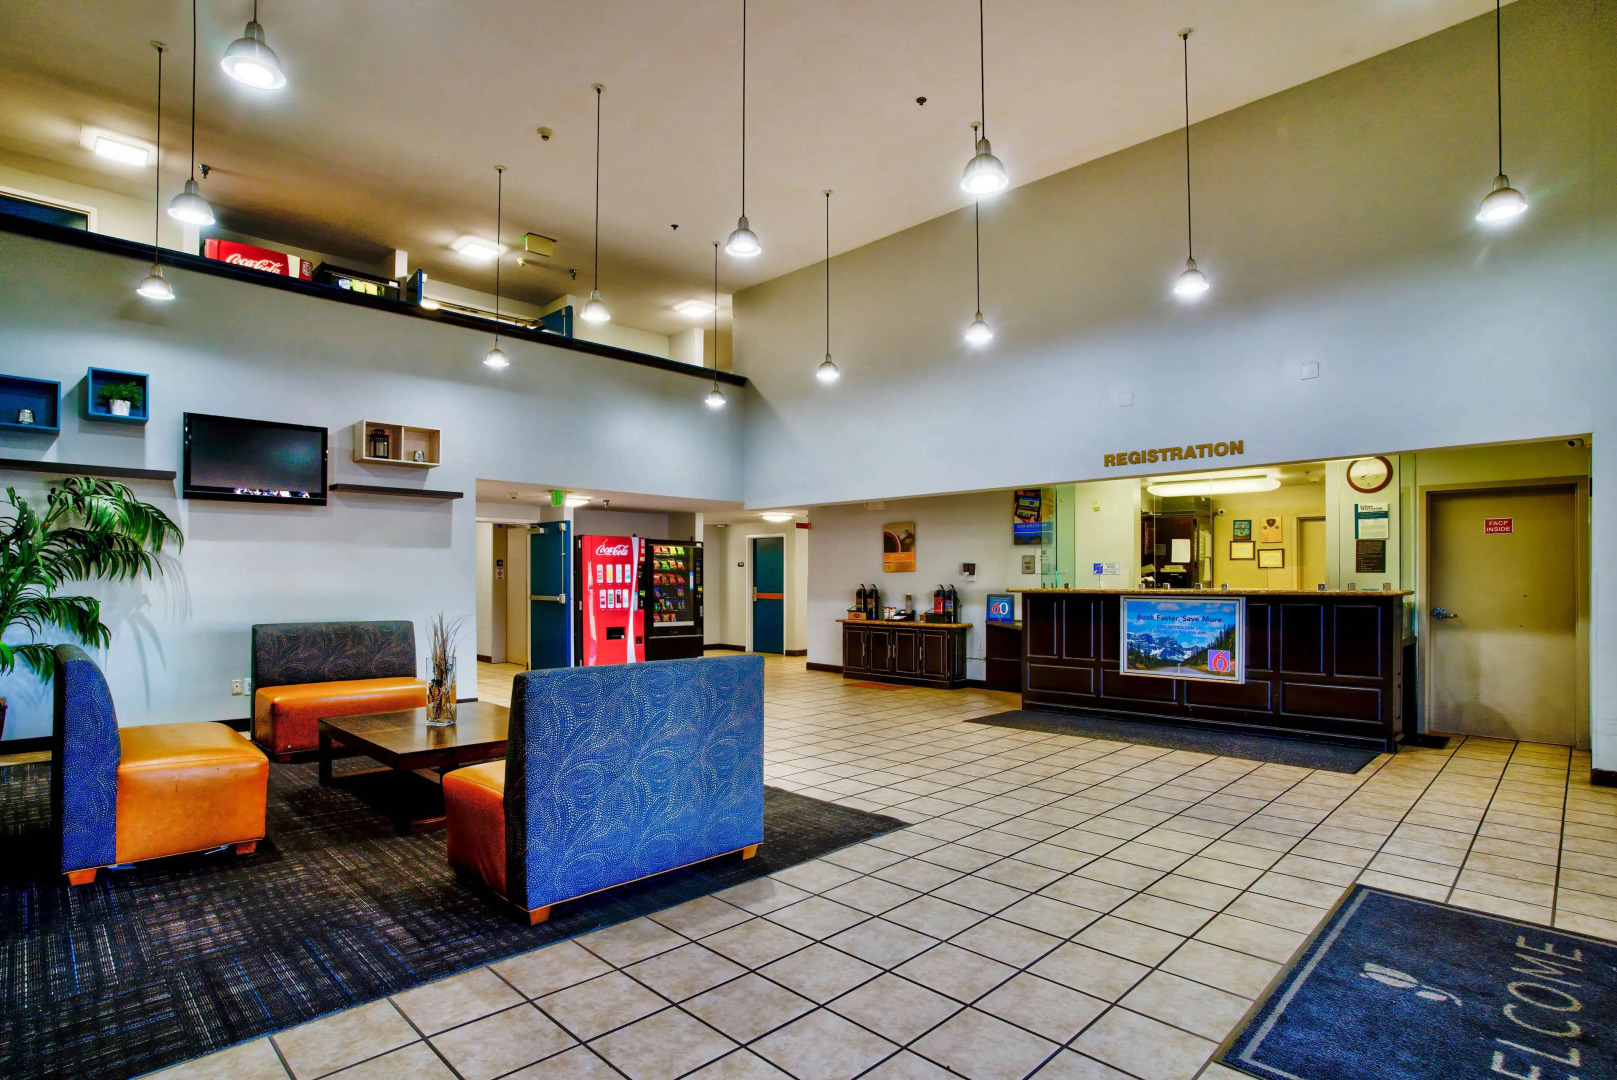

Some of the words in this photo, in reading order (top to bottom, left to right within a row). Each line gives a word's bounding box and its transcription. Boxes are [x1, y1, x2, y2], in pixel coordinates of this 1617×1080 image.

[1103, 439, 1244, 468] REGISTRATION
[595, 544, 630, 556] Coca-Cola
[1156, 614, 1181, 622] Faster.
[1213, 651, 1228, 671] 6
